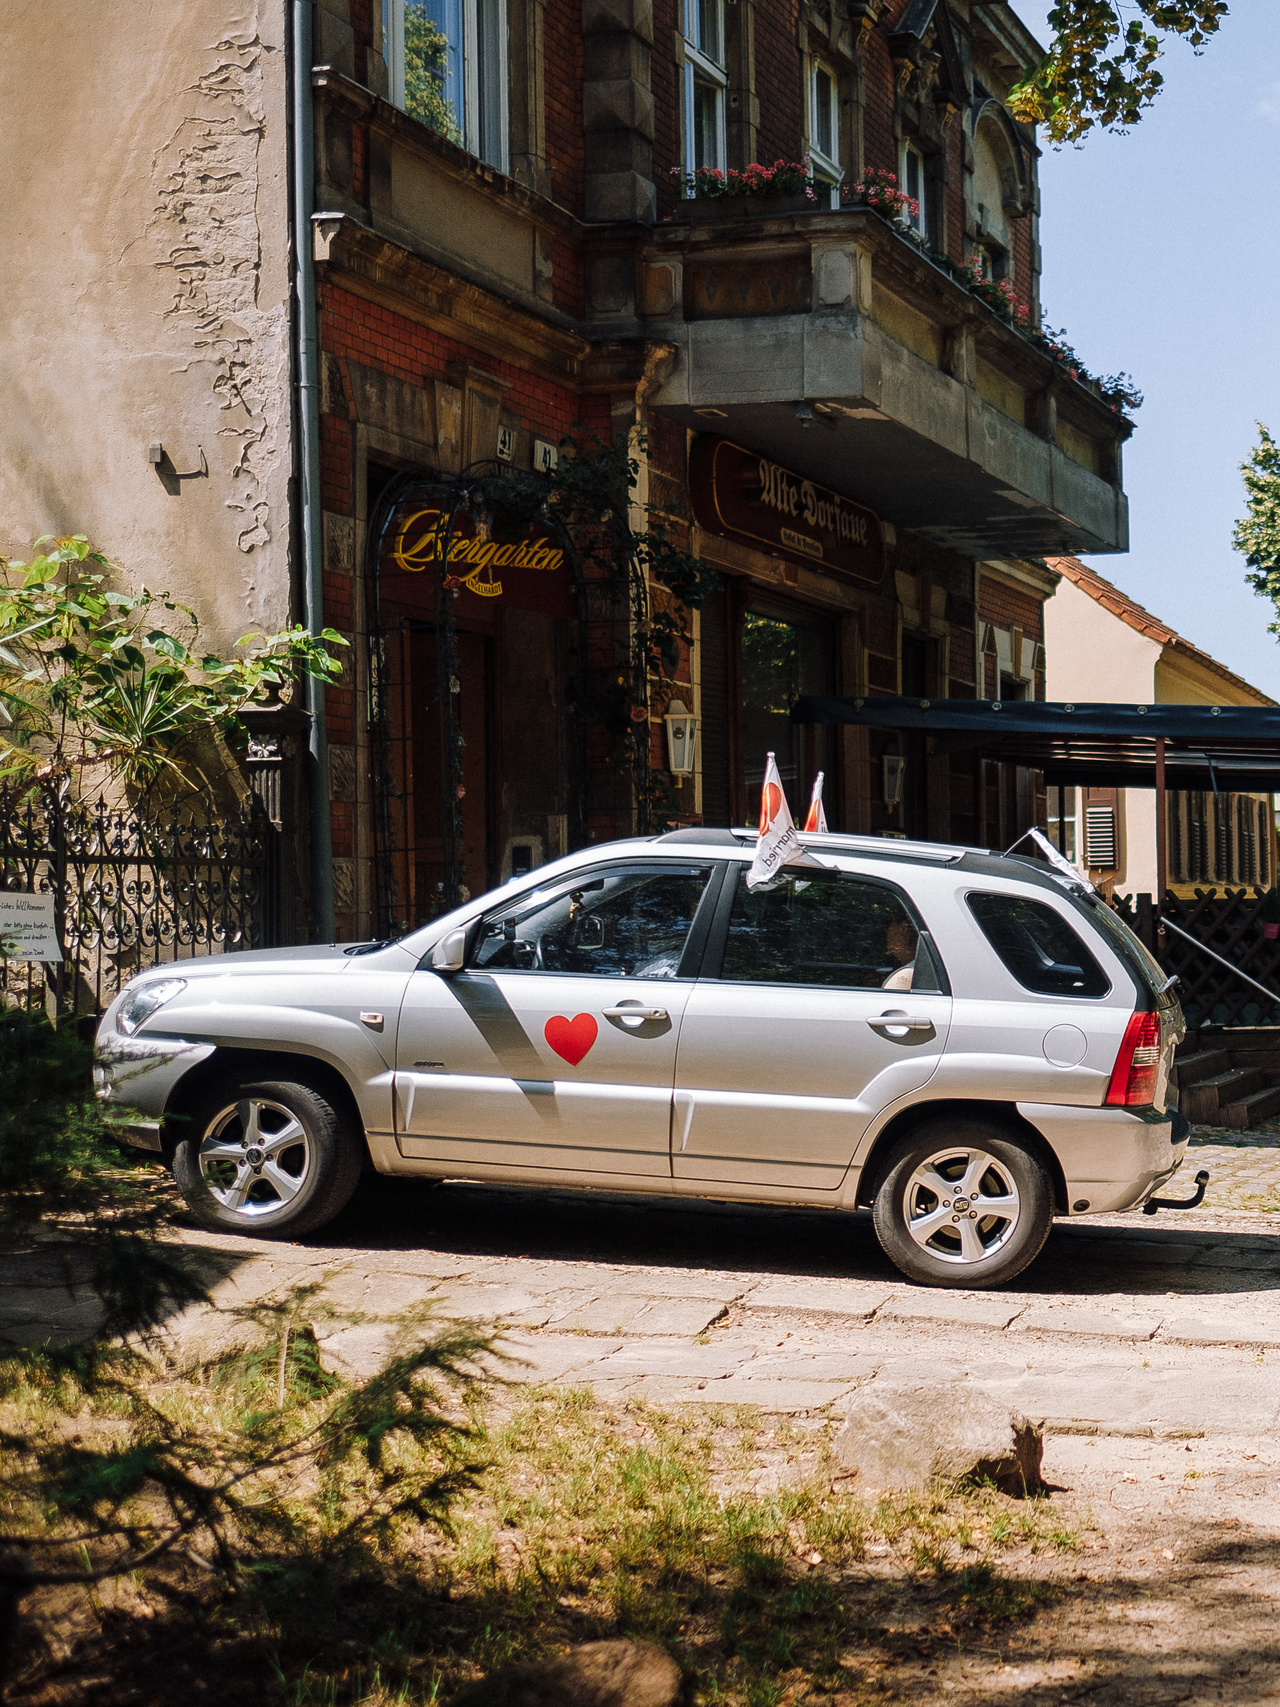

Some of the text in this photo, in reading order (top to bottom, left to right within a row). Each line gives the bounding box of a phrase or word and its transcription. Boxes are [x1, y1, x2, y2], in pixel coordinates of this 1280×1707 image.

[500, 429, 511, 452] 41
[759, 459, 868, 547] Alte Dorfaue
[388, 509, 564, 582] Biergarten
[467, 577, 502, 594] ENGELHARDT
